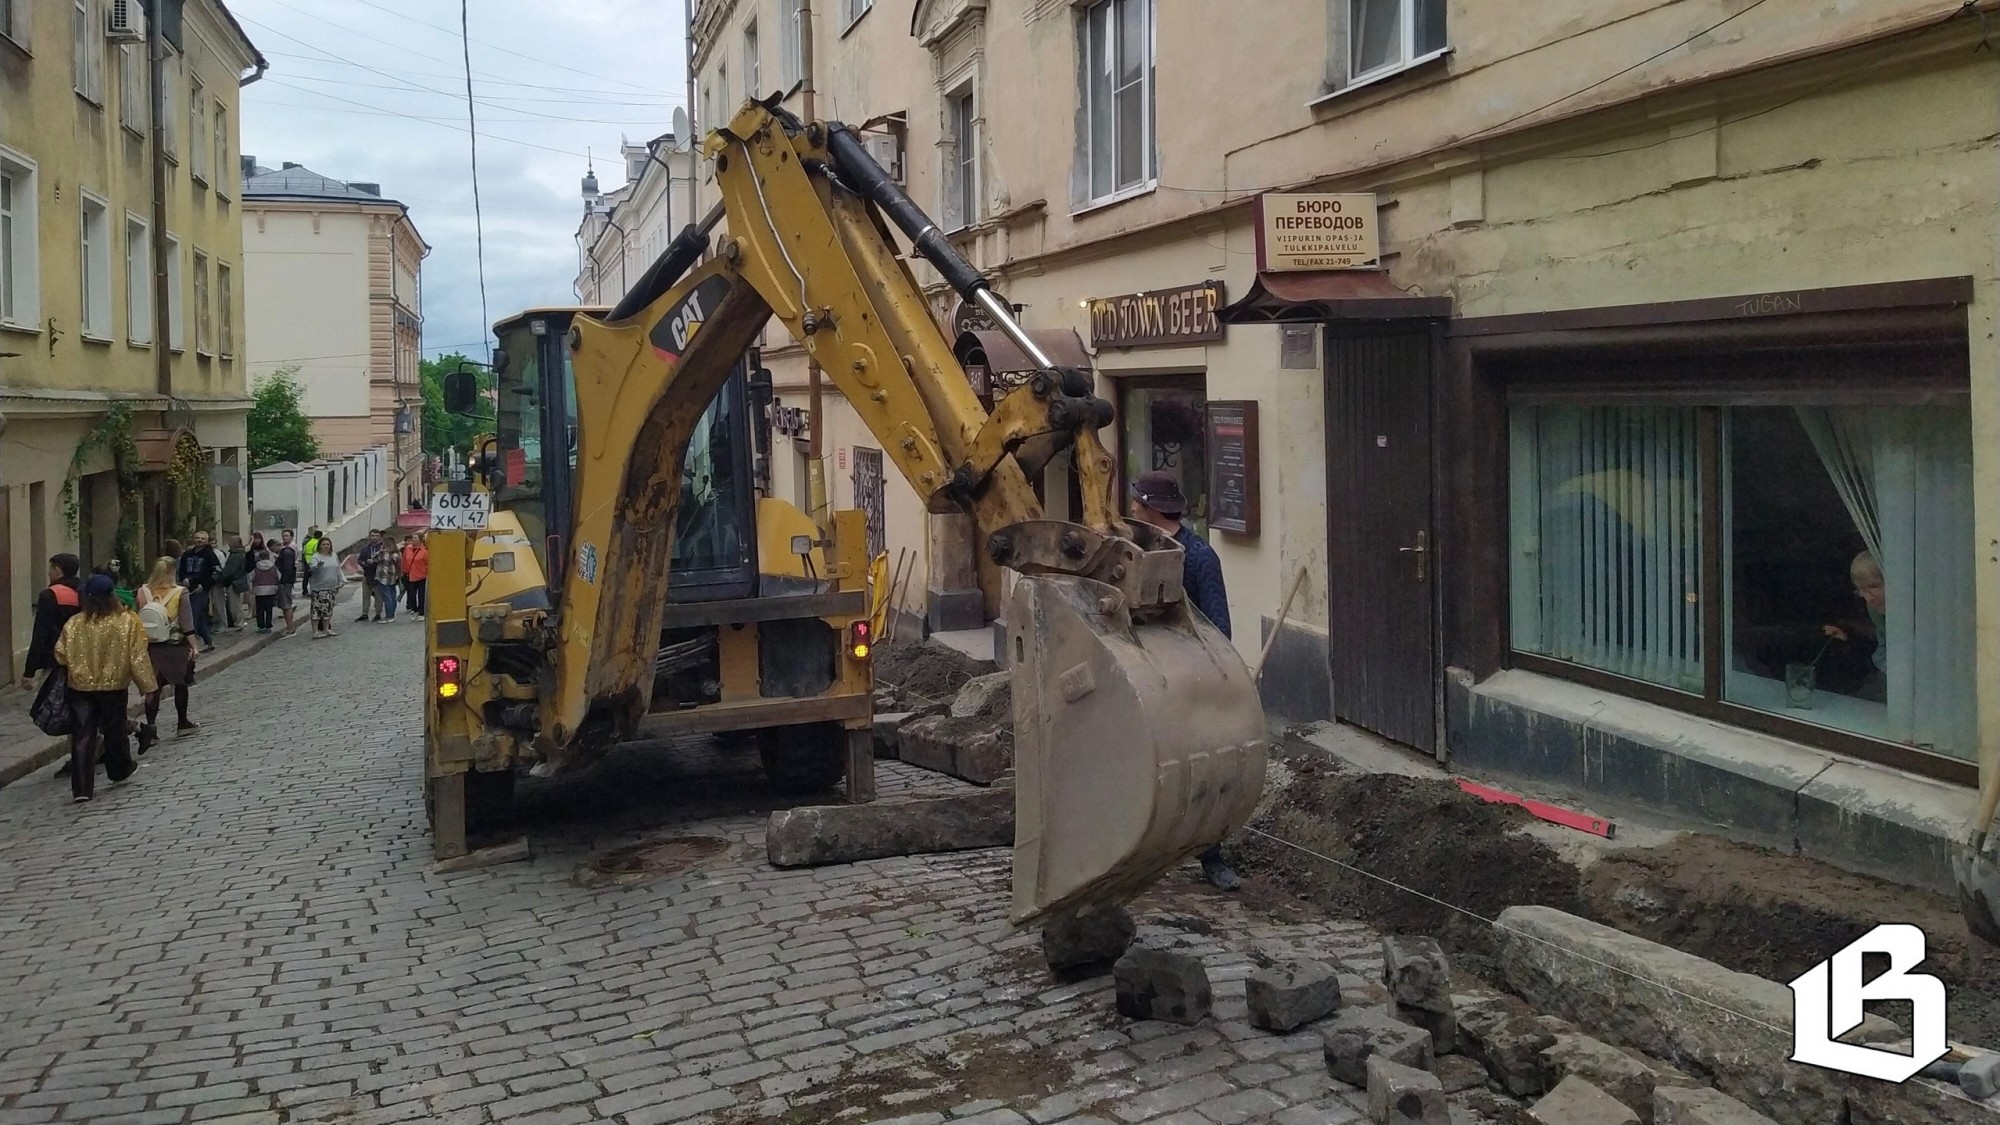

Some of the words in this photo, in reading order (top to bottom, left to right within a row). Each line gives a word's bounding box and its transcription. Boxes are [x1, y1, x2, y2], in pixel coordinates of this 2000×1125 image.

[1297, 201, 1341, 213] БЮРО
[1276, 217, 1364, 230] ПЕРЕВОДОВ
[1293, 258, 1323, 266] TEL/FAX
[671, 289, 705, 351] CAT
[1091, 301, 1118, 342] OLD
[1121, 296, 1165, 340] TOWN
[1169, 287, 1218, 335] BEER
[439, 494, 482, 509] 6034
[468, 511, 484, 524] 47
